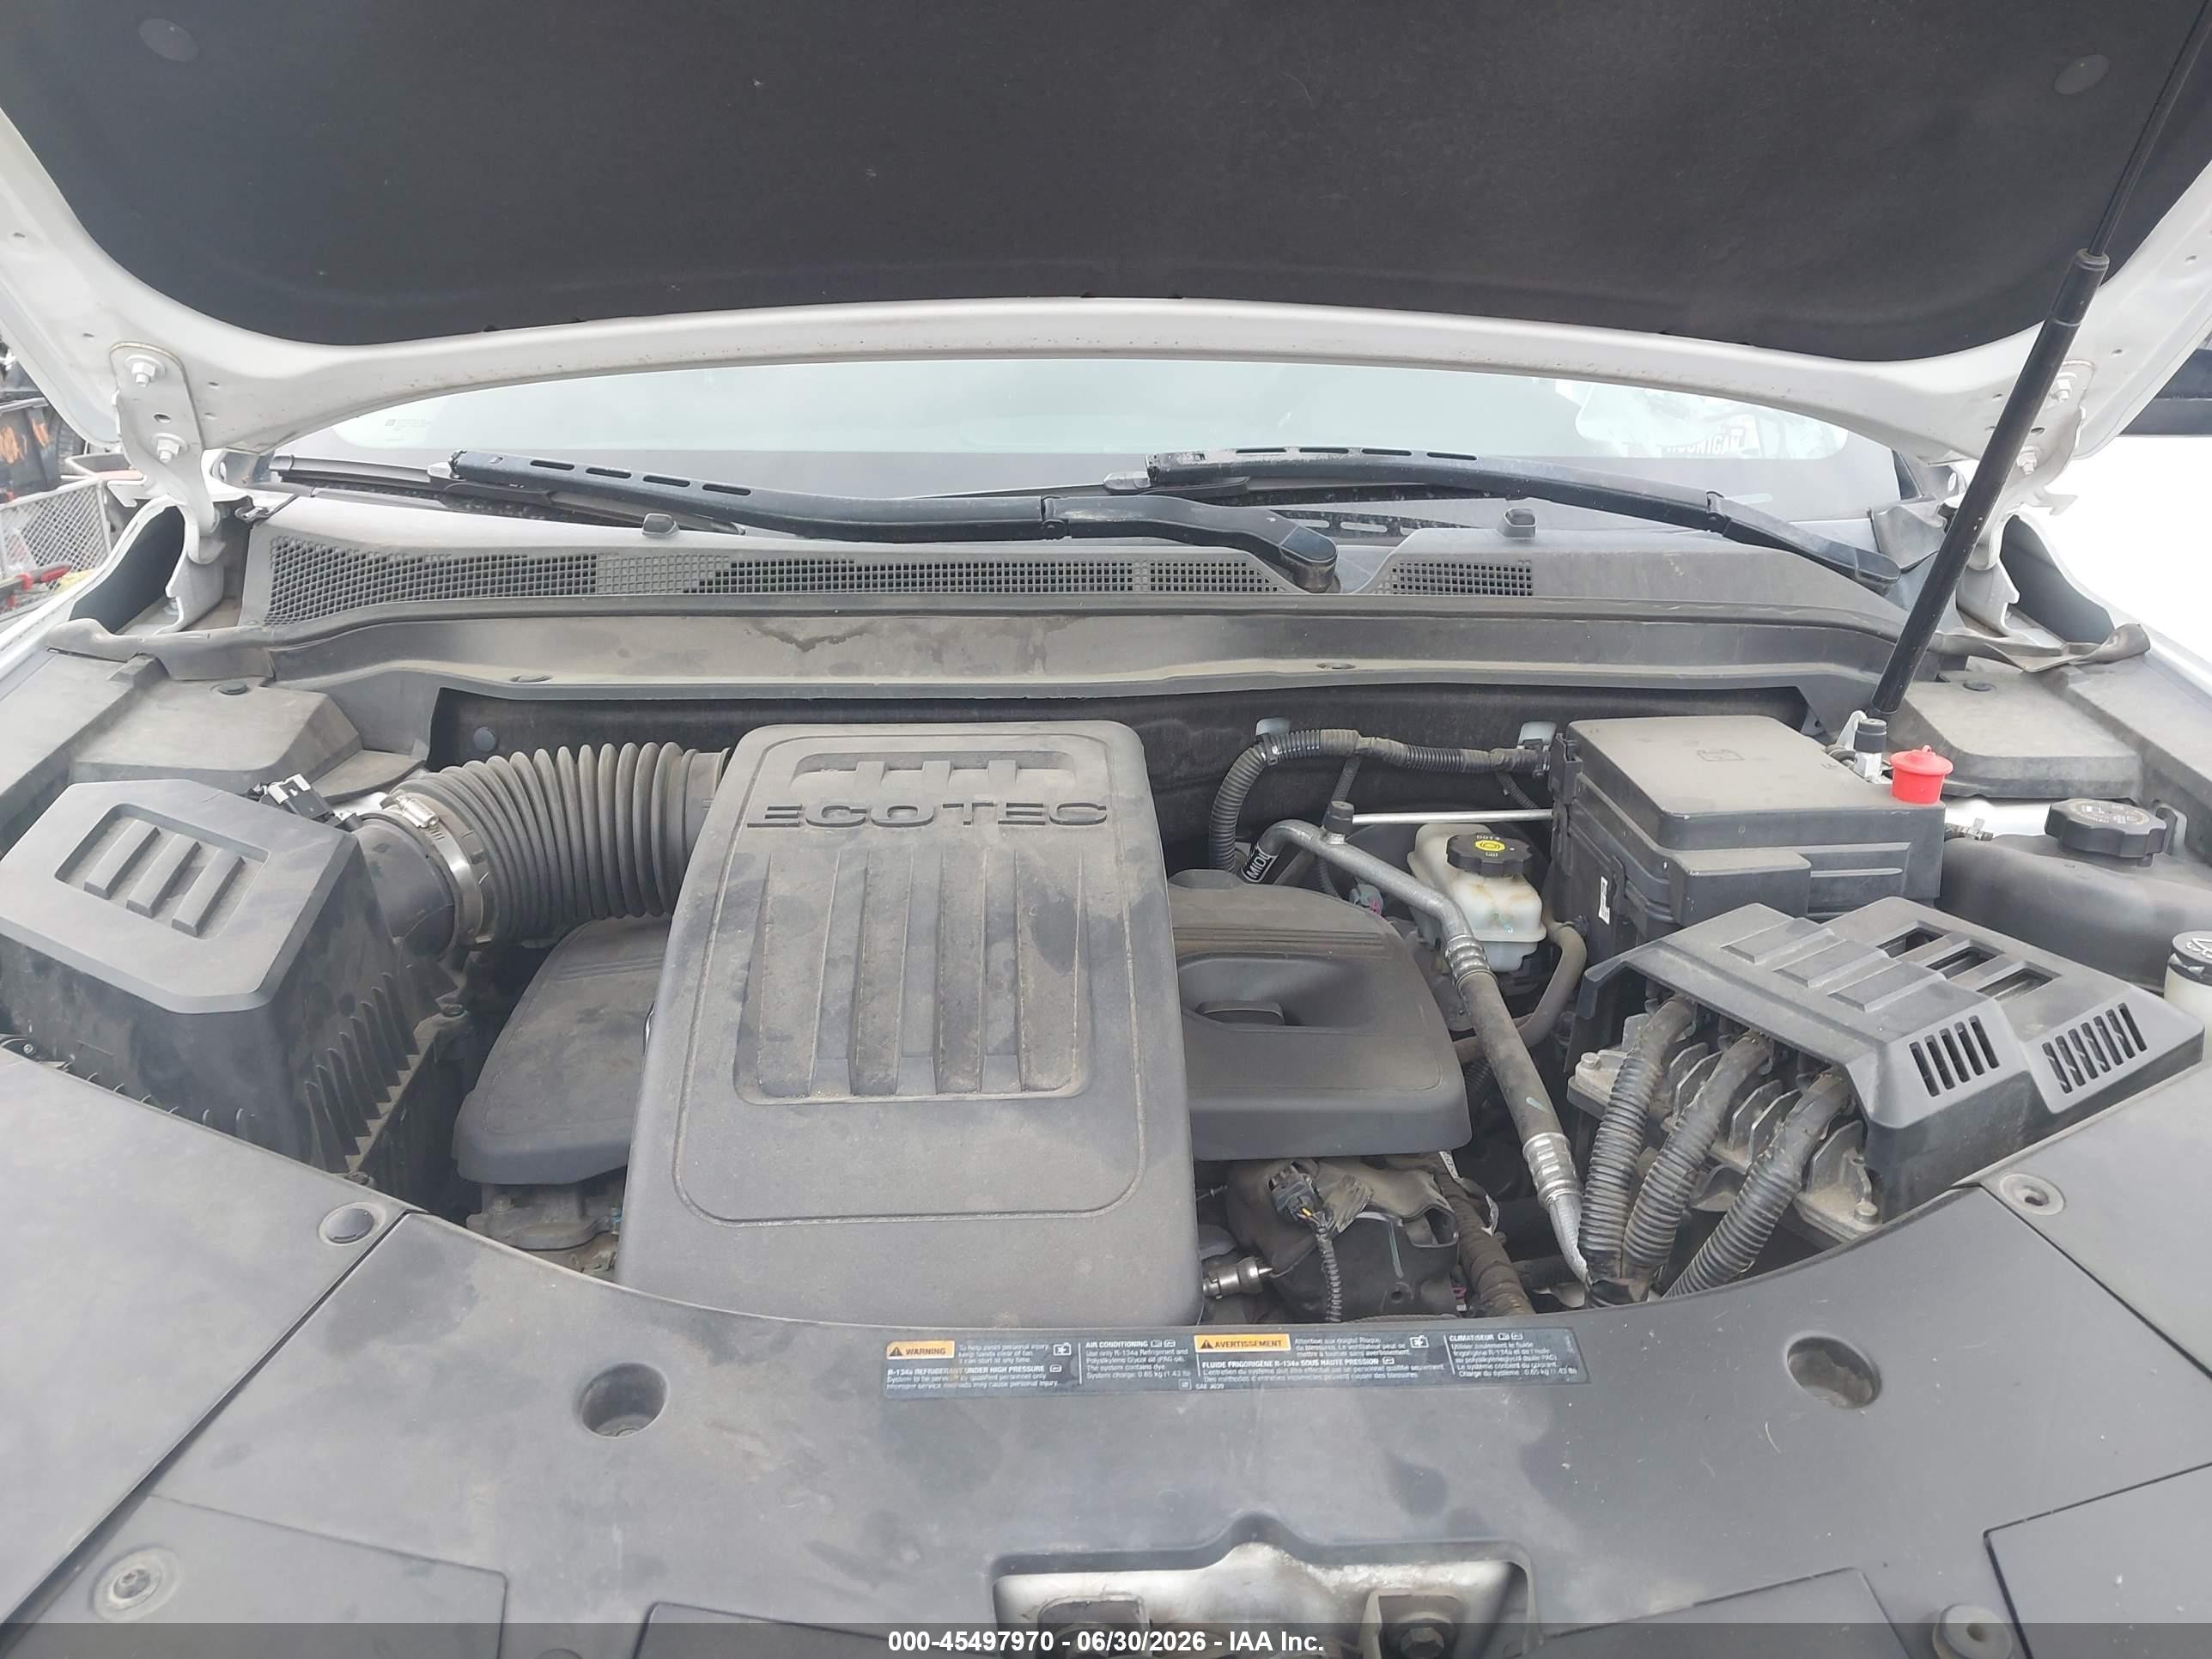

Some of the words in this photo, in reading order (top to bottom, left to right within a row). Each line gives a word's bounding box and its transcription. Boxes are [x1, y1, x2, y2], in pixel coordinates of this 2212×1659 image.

[746, 801, 1108, 828] ECOTEC
[1214, 1340, 1282, 1349] AVERTISSEMENT
[964, 1366, 988, 1375] UNDER
[1008, 1365, 1044, 1374] PRESSURE
